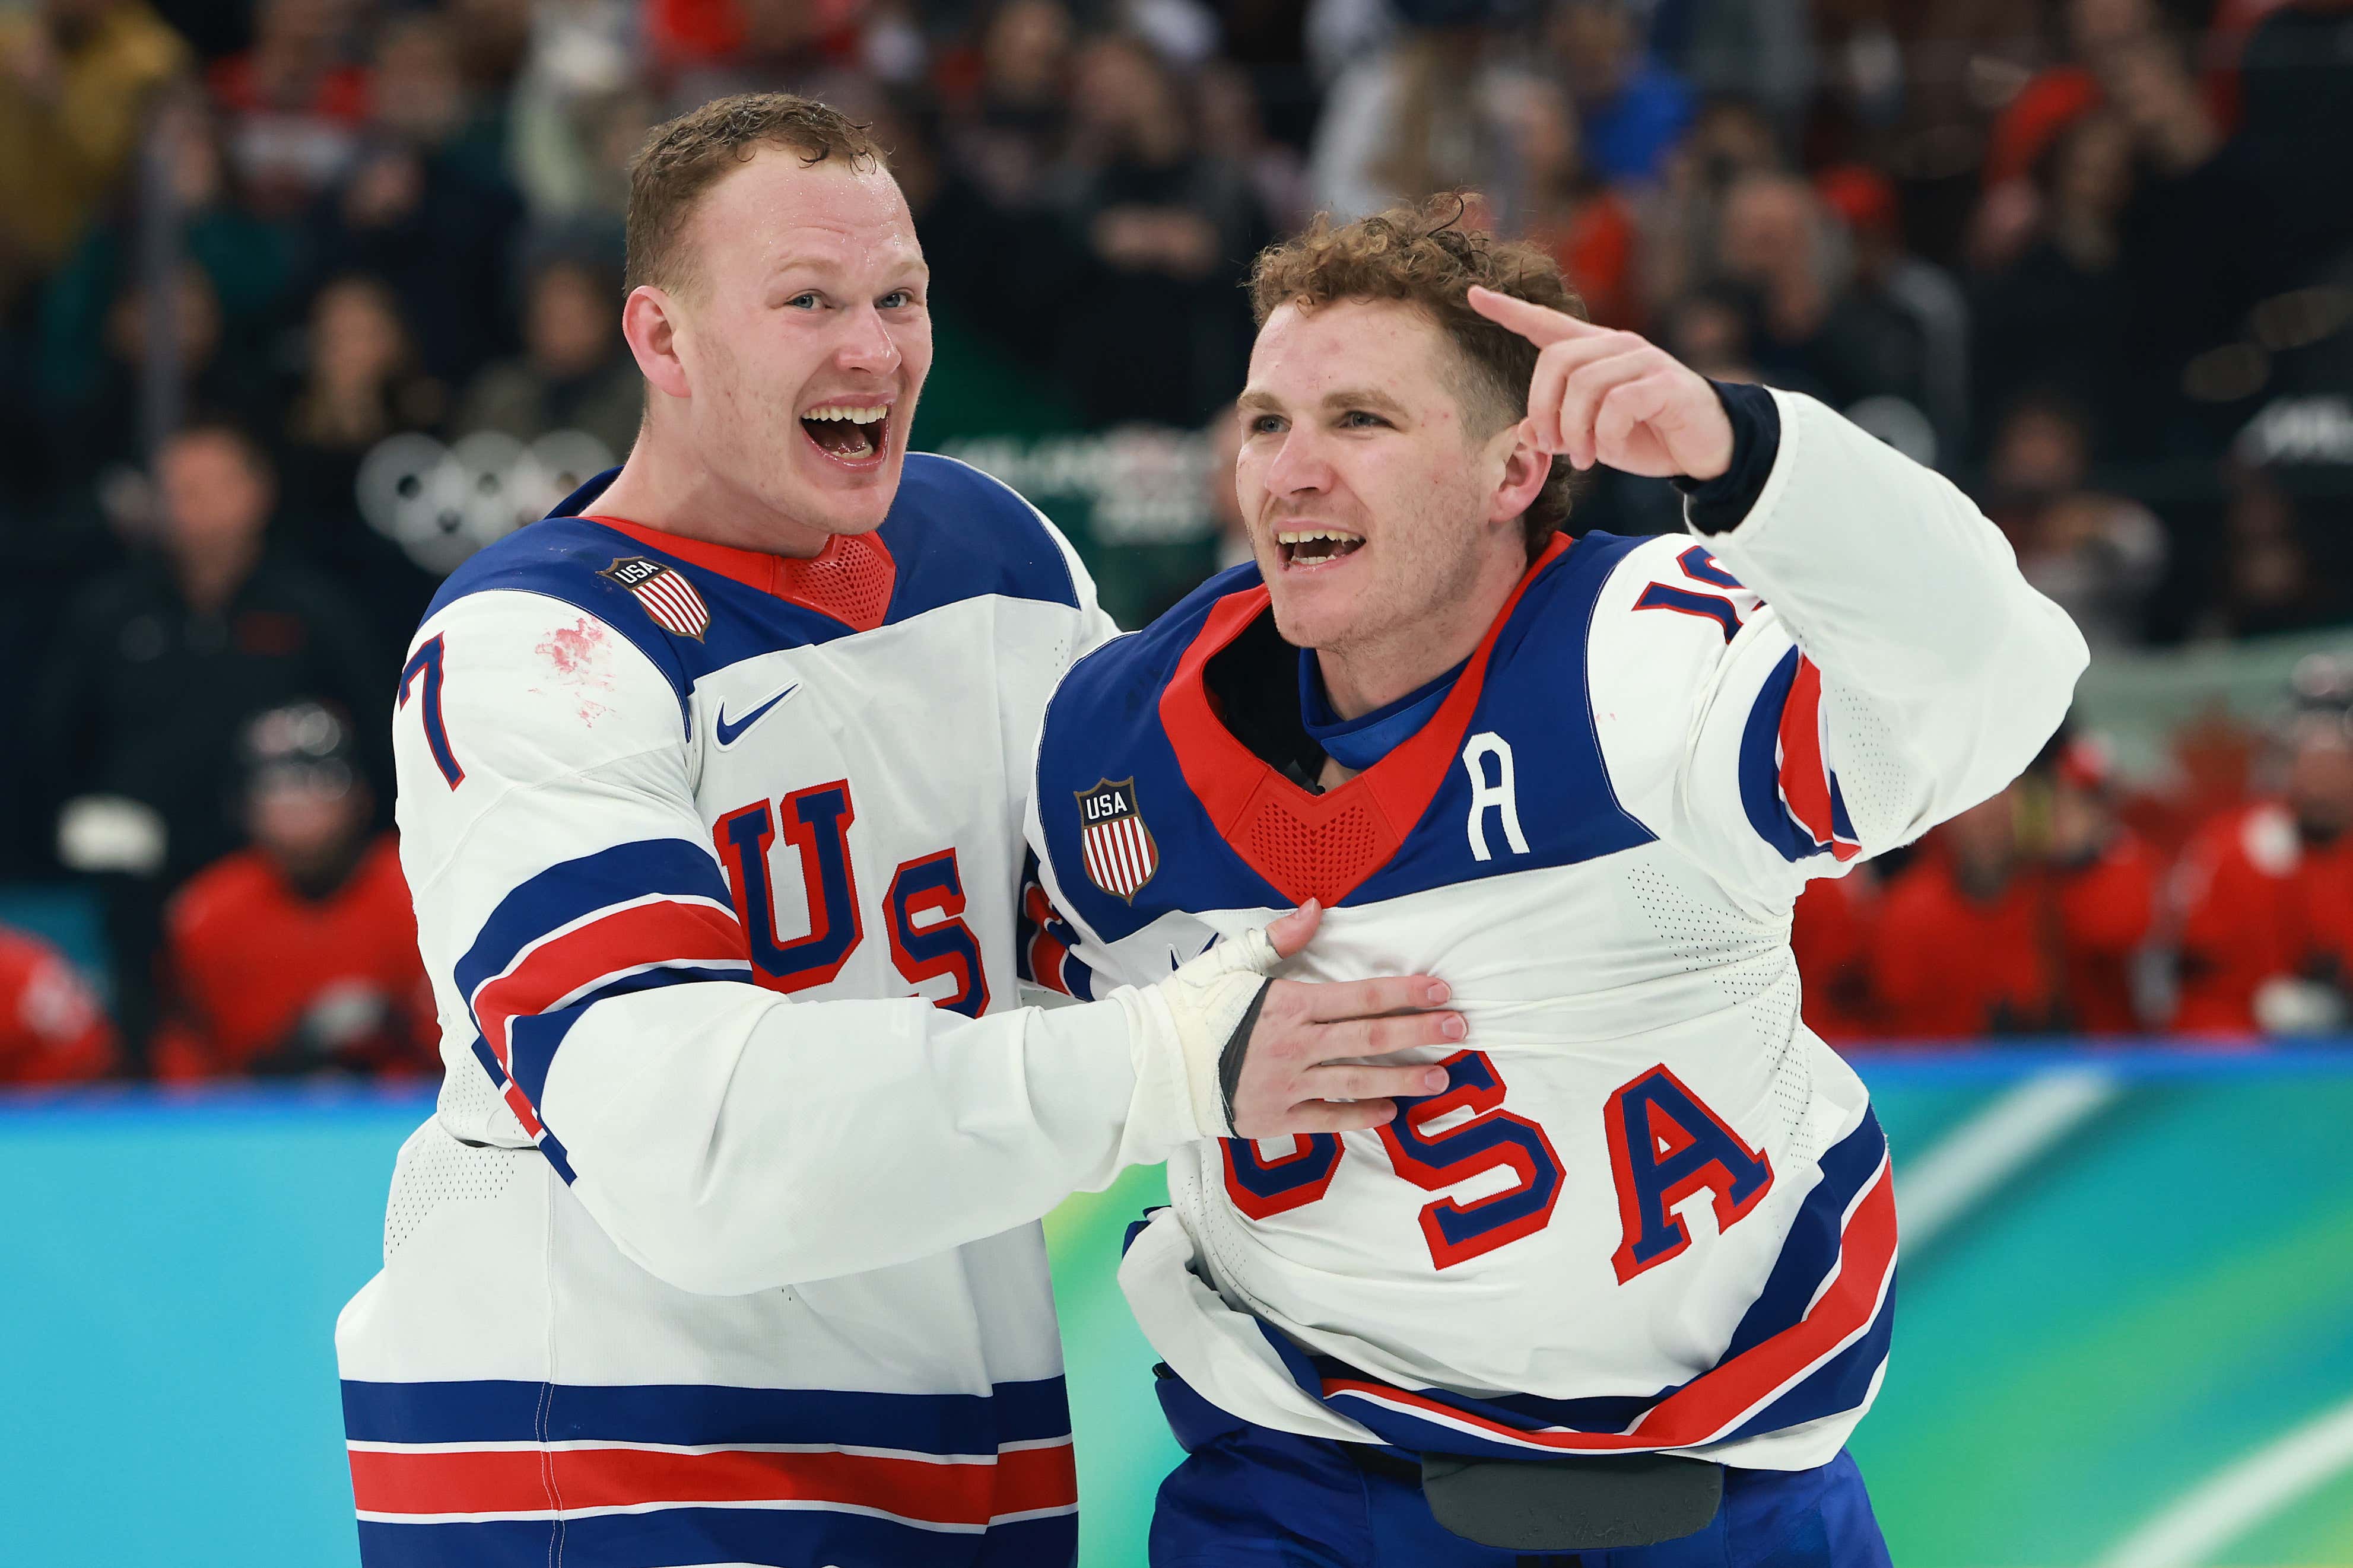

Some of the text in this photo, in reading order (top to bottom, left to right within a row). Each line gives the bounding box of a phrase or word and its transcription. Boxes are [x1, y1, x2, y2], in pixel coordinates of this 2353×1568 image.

[614, 561, 659, 584] USA
[399, 630, 466, 793] 7
[1086, 791, 1128, 820] USA
[1462, 731, 1530, 861] A
